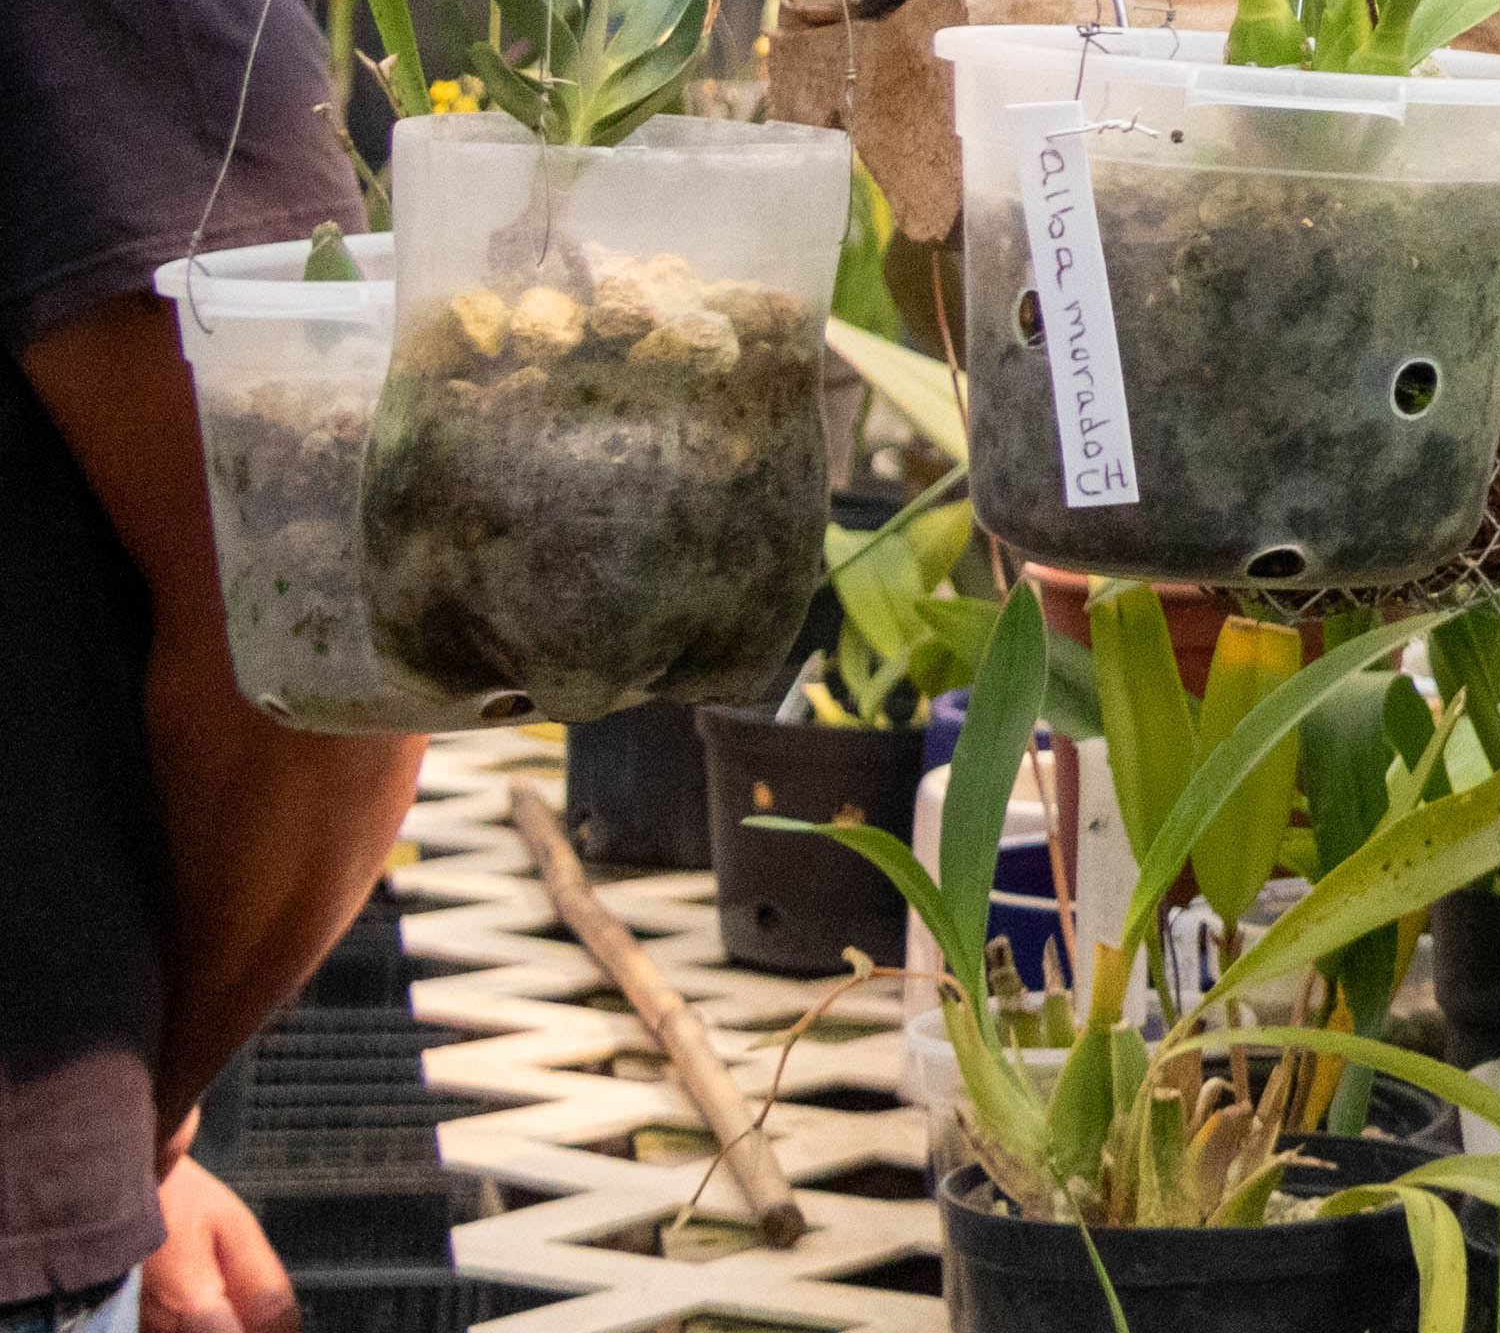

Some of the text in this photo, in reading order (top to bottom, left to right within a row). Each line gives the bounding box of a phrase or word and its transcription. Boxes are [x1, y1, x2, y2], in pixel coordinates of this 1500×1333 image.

[1040, 148, 1111, 459] alba morado
[1075, 458, 1129, 496] CH
